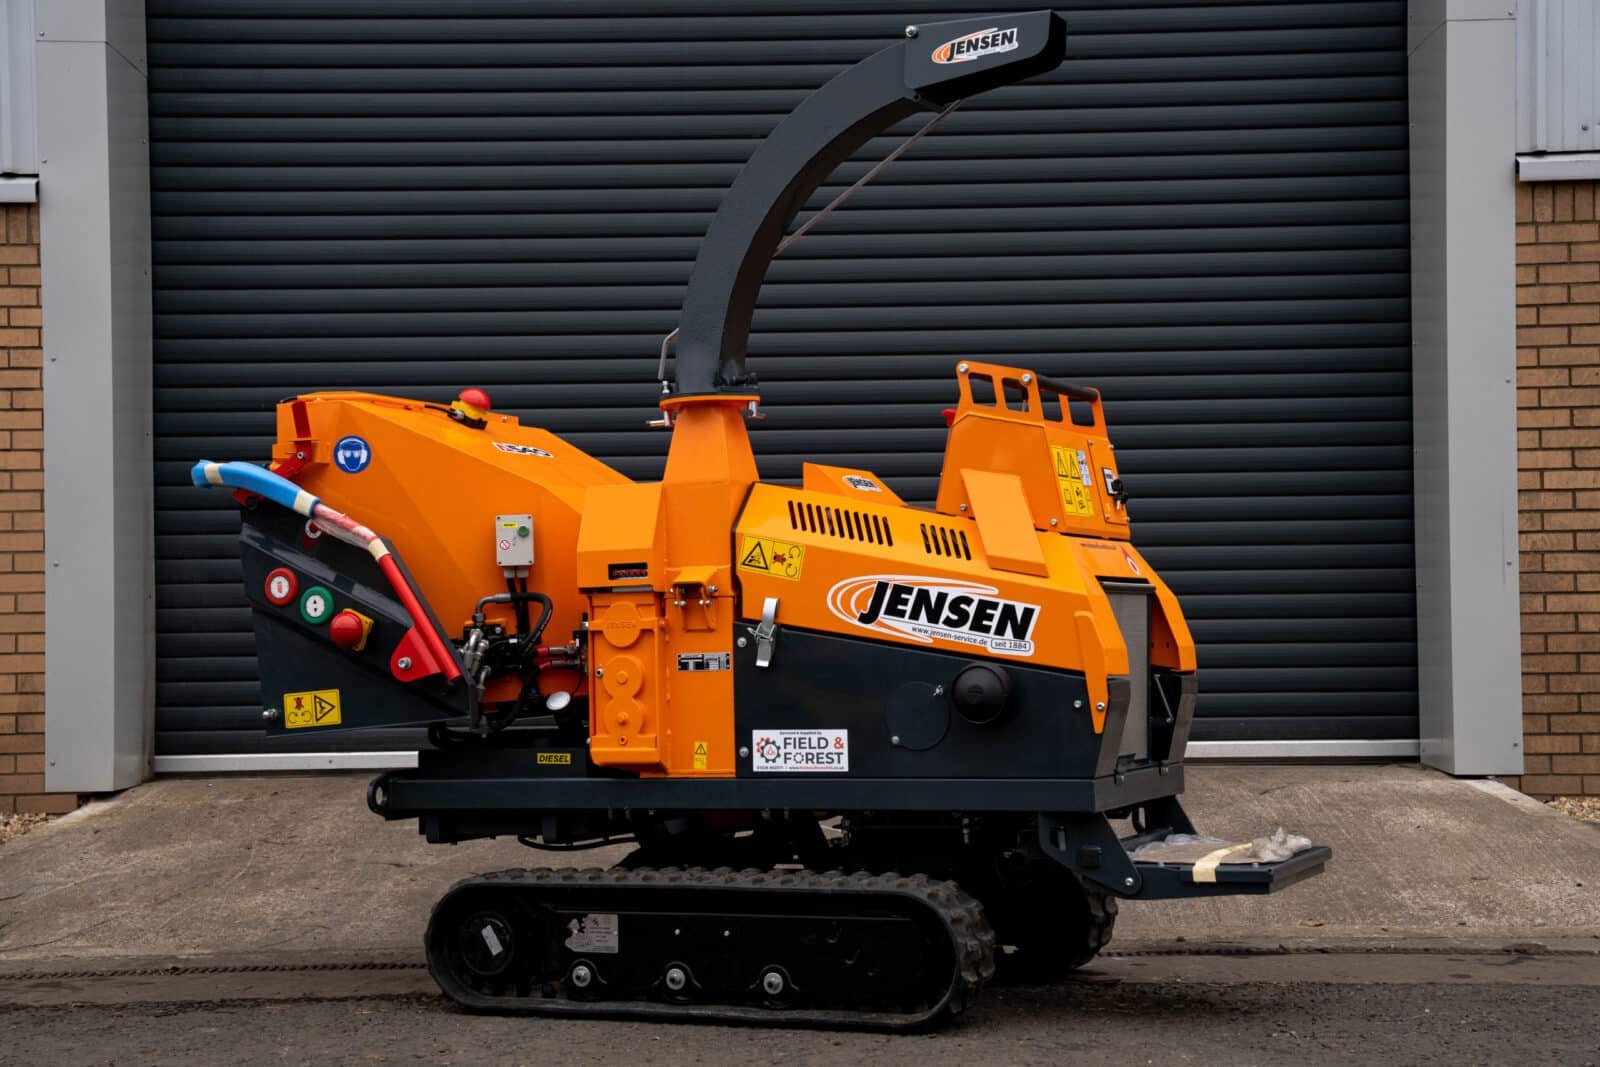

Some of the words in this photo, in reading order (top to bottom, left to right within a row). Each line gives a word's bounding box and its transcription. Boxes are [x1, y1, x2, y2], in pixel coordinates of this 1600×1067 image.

[946, 30, 1015, 62] JENSEN
[857, 580, 1035, 641] JENSEN
[911, 626, 988, 646] www.jensen-service.de
[994, 640, 1007, 648] seit
[1009, 640, 1028, 650] 1884
[783, 737, 829, 750] FIELD
[833, 736, 844, 750] &
[538, 754, 570, 763] DIESEL
[783, 752, 844, 765] FOREST
